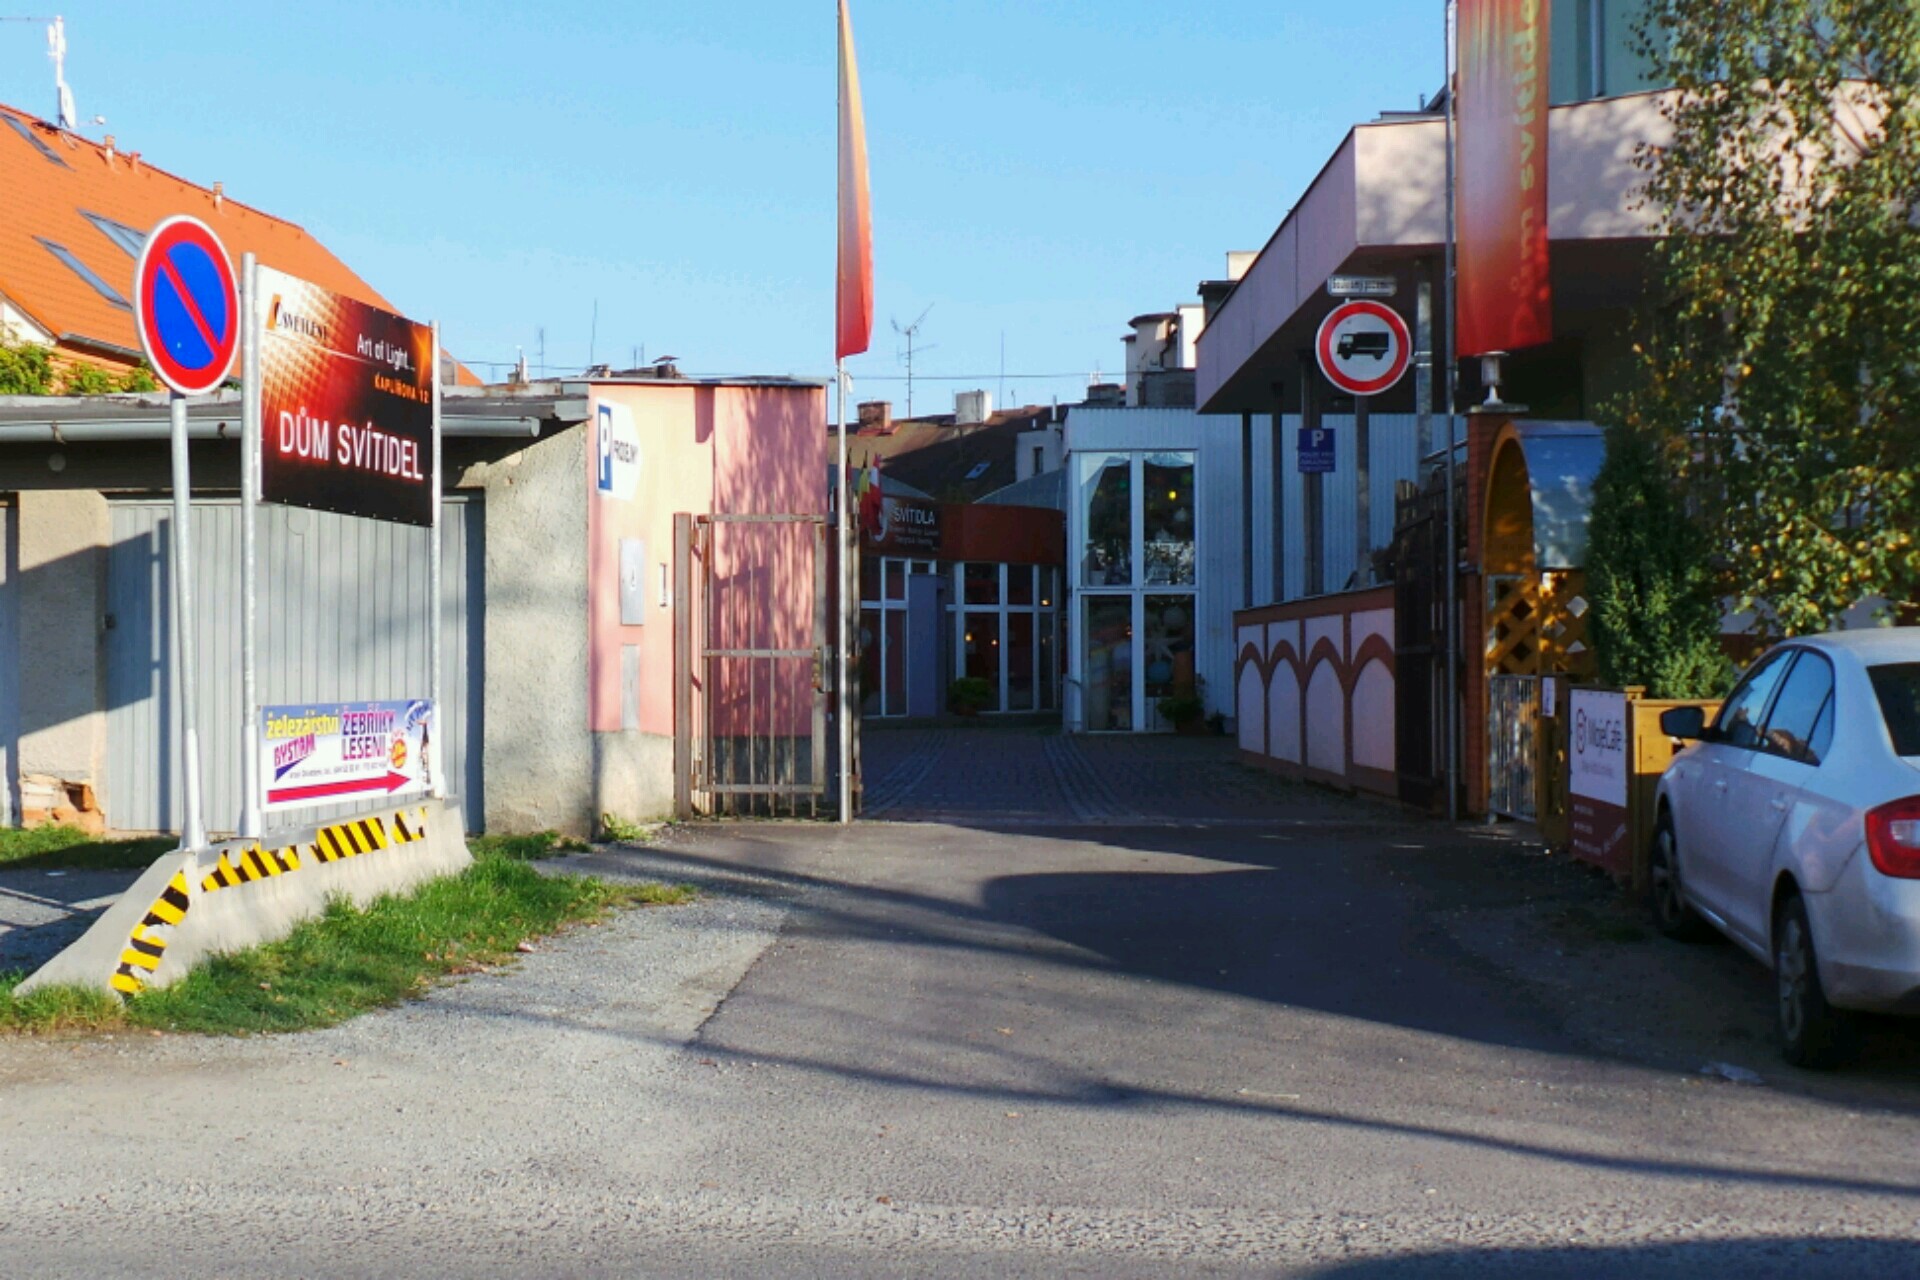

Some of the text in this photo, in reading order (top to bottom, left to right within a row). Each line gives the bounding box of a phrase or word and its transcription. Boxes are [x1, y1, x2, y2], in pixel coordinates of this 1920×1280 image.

[357, 333, 373, 358] Art
[375, 339, 384, 360] of
[419, 388, 430, 404] 12
[279, 405, 424, 481] DŮM SVÍTIDEL
[599, 412, 612, 480] P
[1311, 430, 1324, 447] P
[894, 505, 935, 526] SVÍTIDLA
[266, 709, 340, 740] železářství
